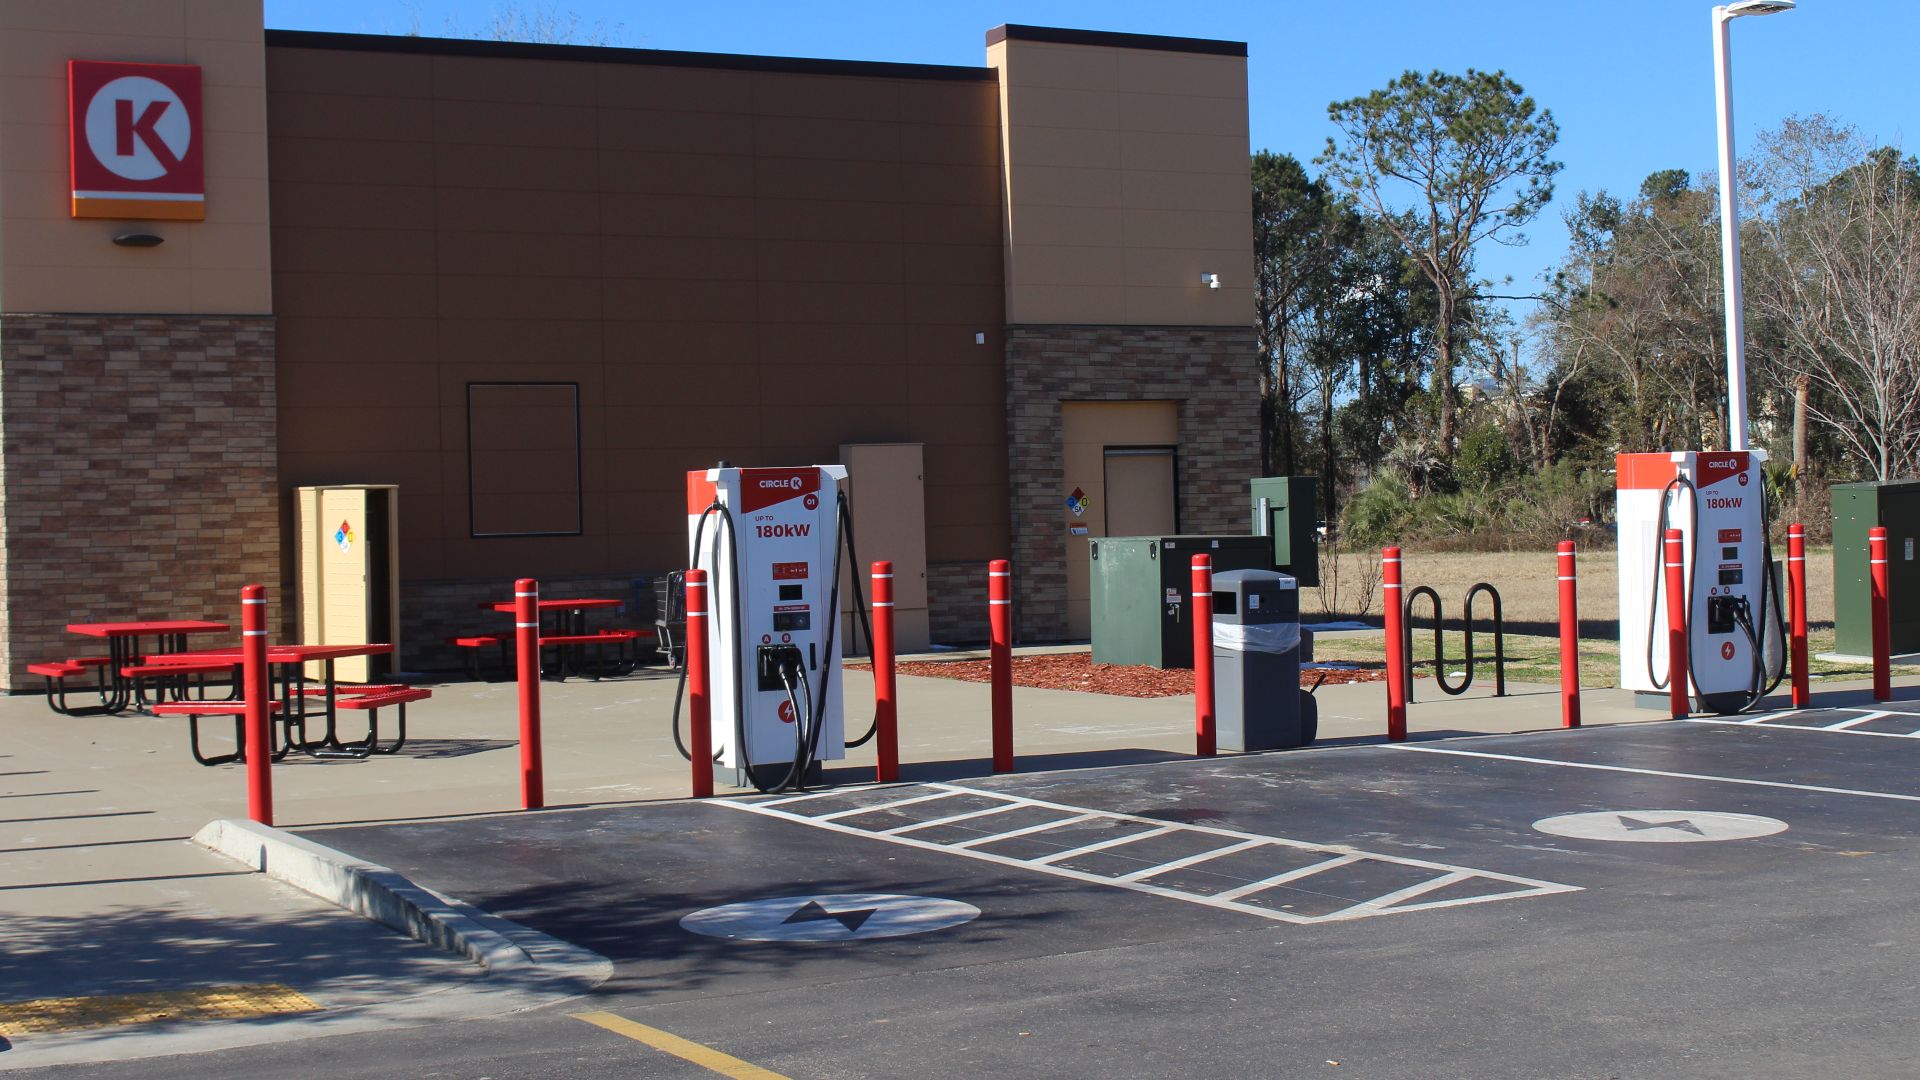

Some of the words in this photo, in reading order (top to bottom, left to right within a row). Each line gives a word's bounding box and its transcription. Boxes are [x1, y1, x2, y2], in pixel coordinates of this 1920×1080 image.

[113, 97, 183, 175] K
[1708, 461, 1729, 469] CIRCLE
[759, 479, 789, 489] CIRCLE
[791, 478, 801, 489] K
[1706, 498, 1743, 509] 180kW
[755, 523, 811, 538] 180kW
